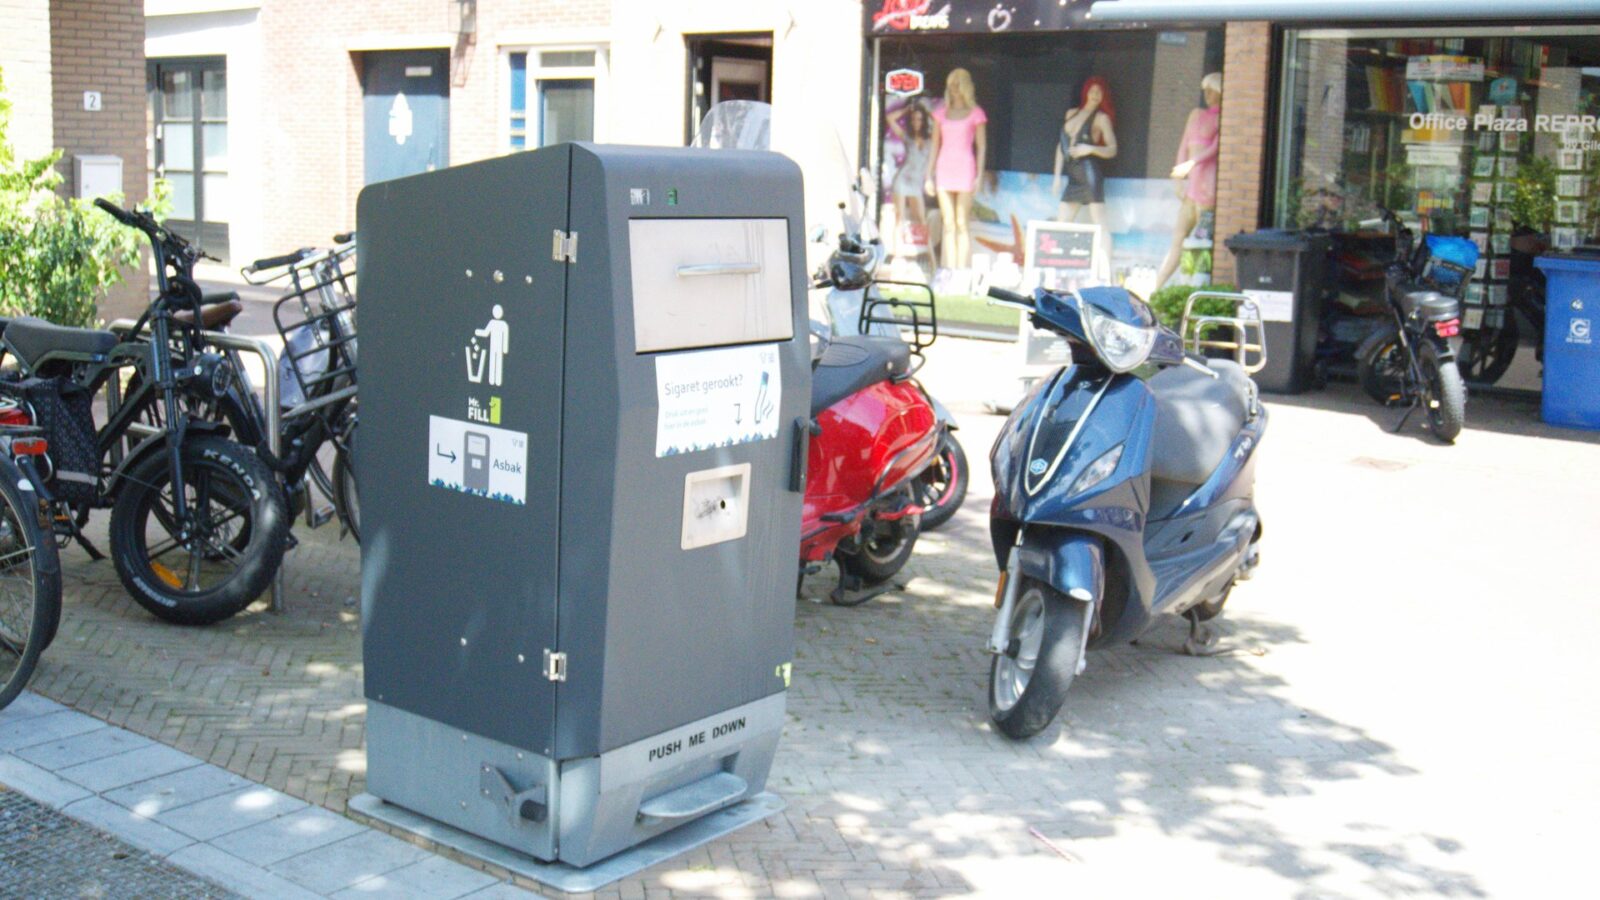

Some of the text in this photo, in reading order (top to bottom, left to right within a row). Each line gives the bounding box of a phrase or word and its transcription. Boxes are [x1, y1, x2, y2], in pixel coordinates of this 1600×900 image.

[1409, 112, 1467, 131] Office
[1474, 114, 1528, 132] Plaza
[1564, 140, 1577, 151] by
[664, 374, 743, 398] Sigaret gerookt?
[468, 396, 480, 408] Mr.
[468, 407, 489, 423] FILL
[203, 449, 261, 500] KENDA
[493, 459, 522, 474] Asbak
[649, 717, 746, 762] PUSH ME DOWN
